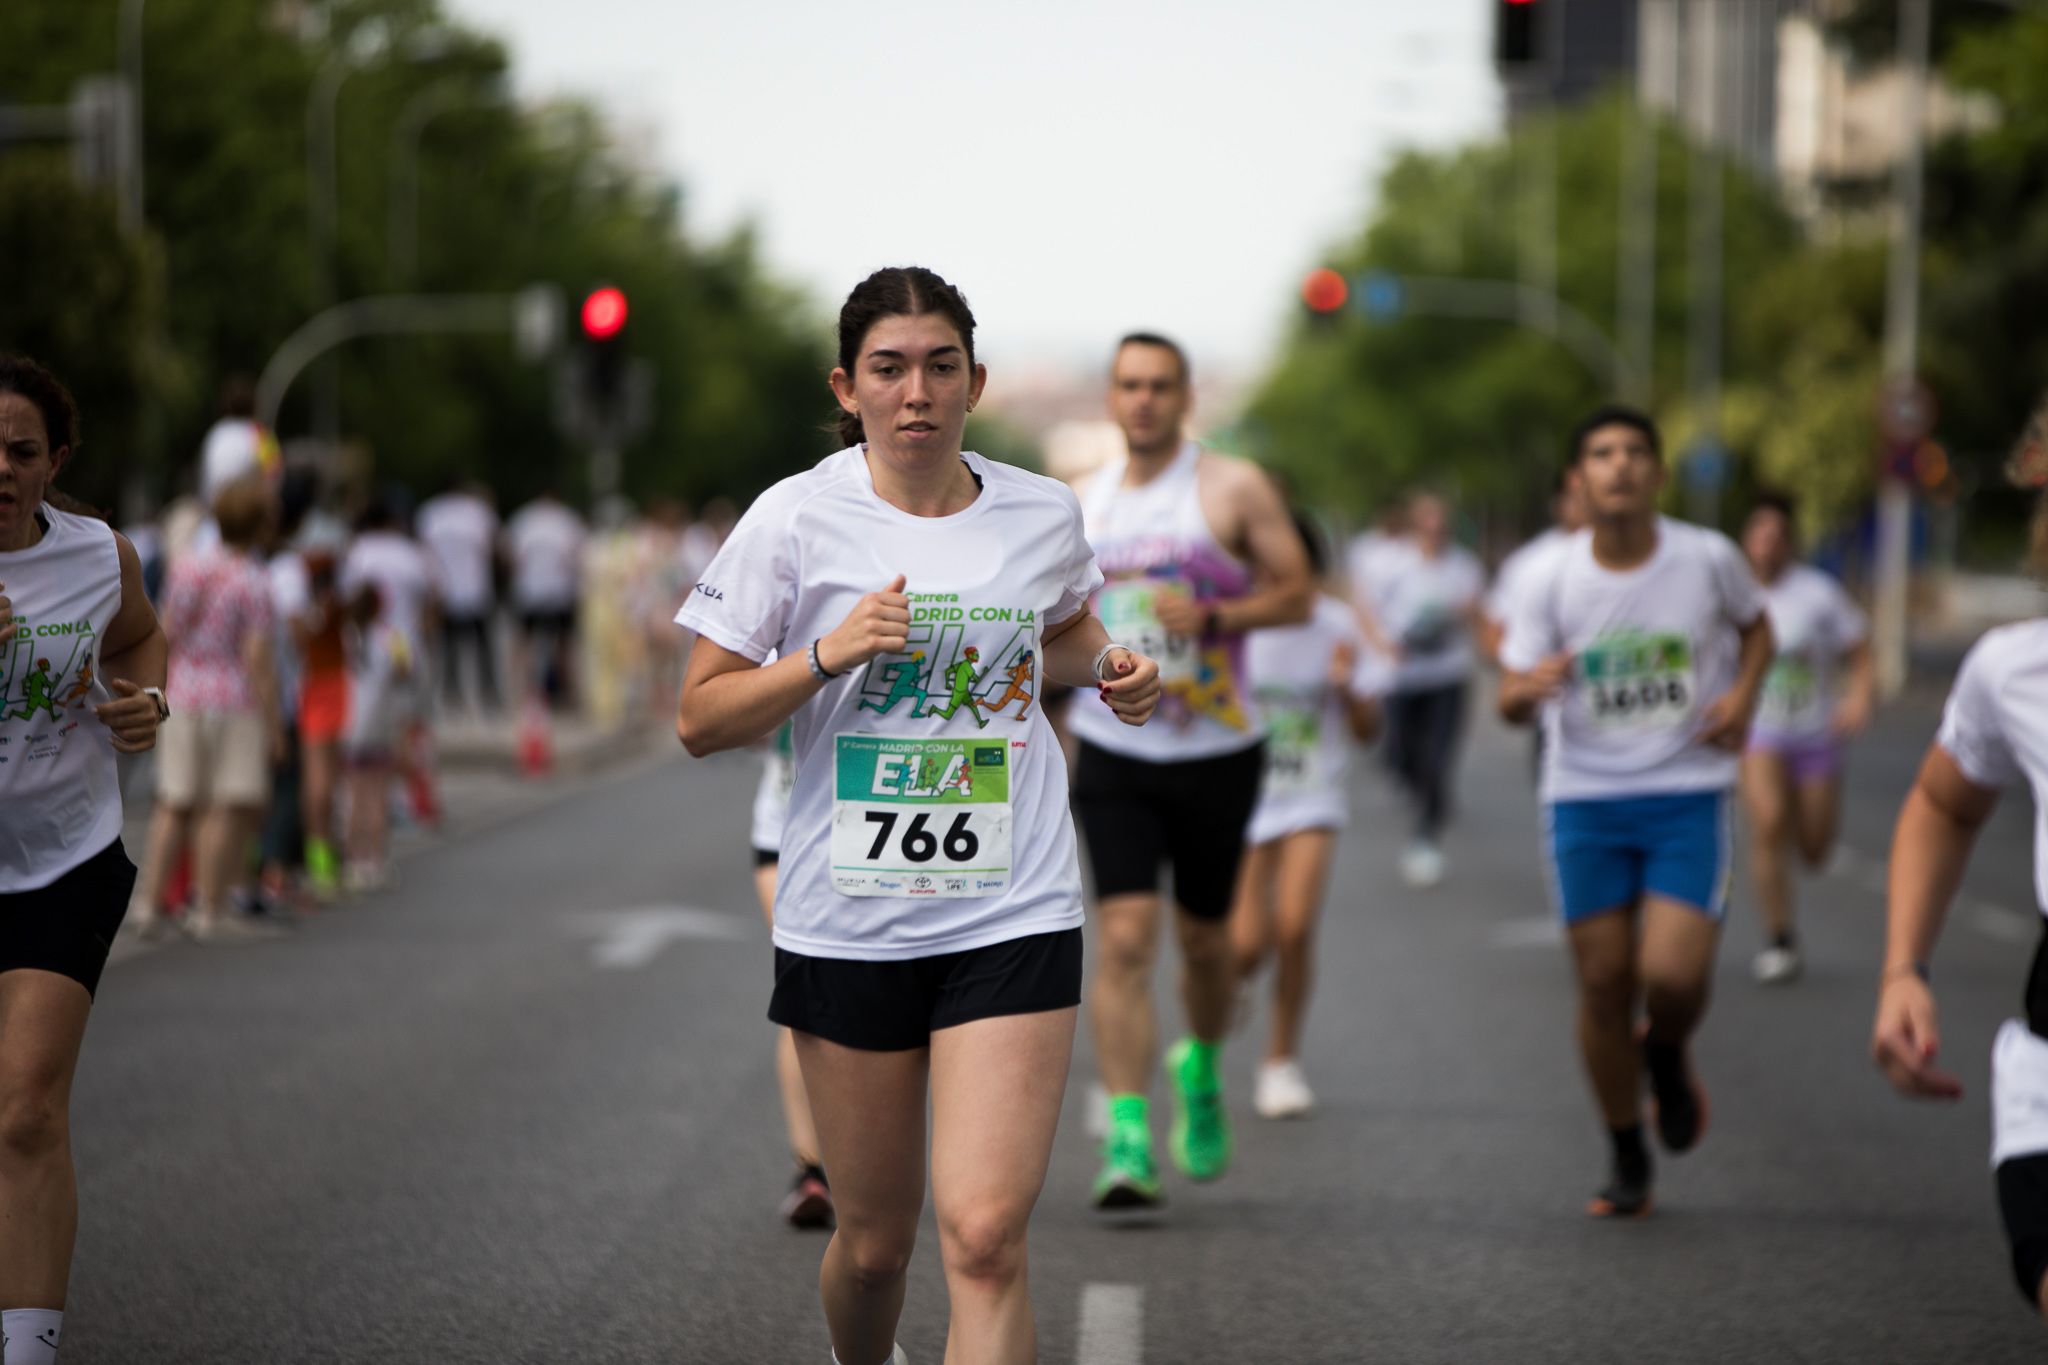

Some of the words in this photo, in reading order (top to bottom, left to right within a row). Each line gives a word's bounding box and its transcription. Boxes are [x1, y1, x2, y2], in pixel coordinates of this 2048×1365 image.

[911, 607, 964, 622] DRID
[969, 608, 1013, 622] CON
[1017, 609, 1035, 623] LA
[36, 622, 73, 637] CON
[879, 743, 924, 753] MADRID
[925, 744, 949, 753] CON
[951, 744, 965, 753] LA
[871, 753, 972, 797] ELA
[865, 811, 979, 863] 766
